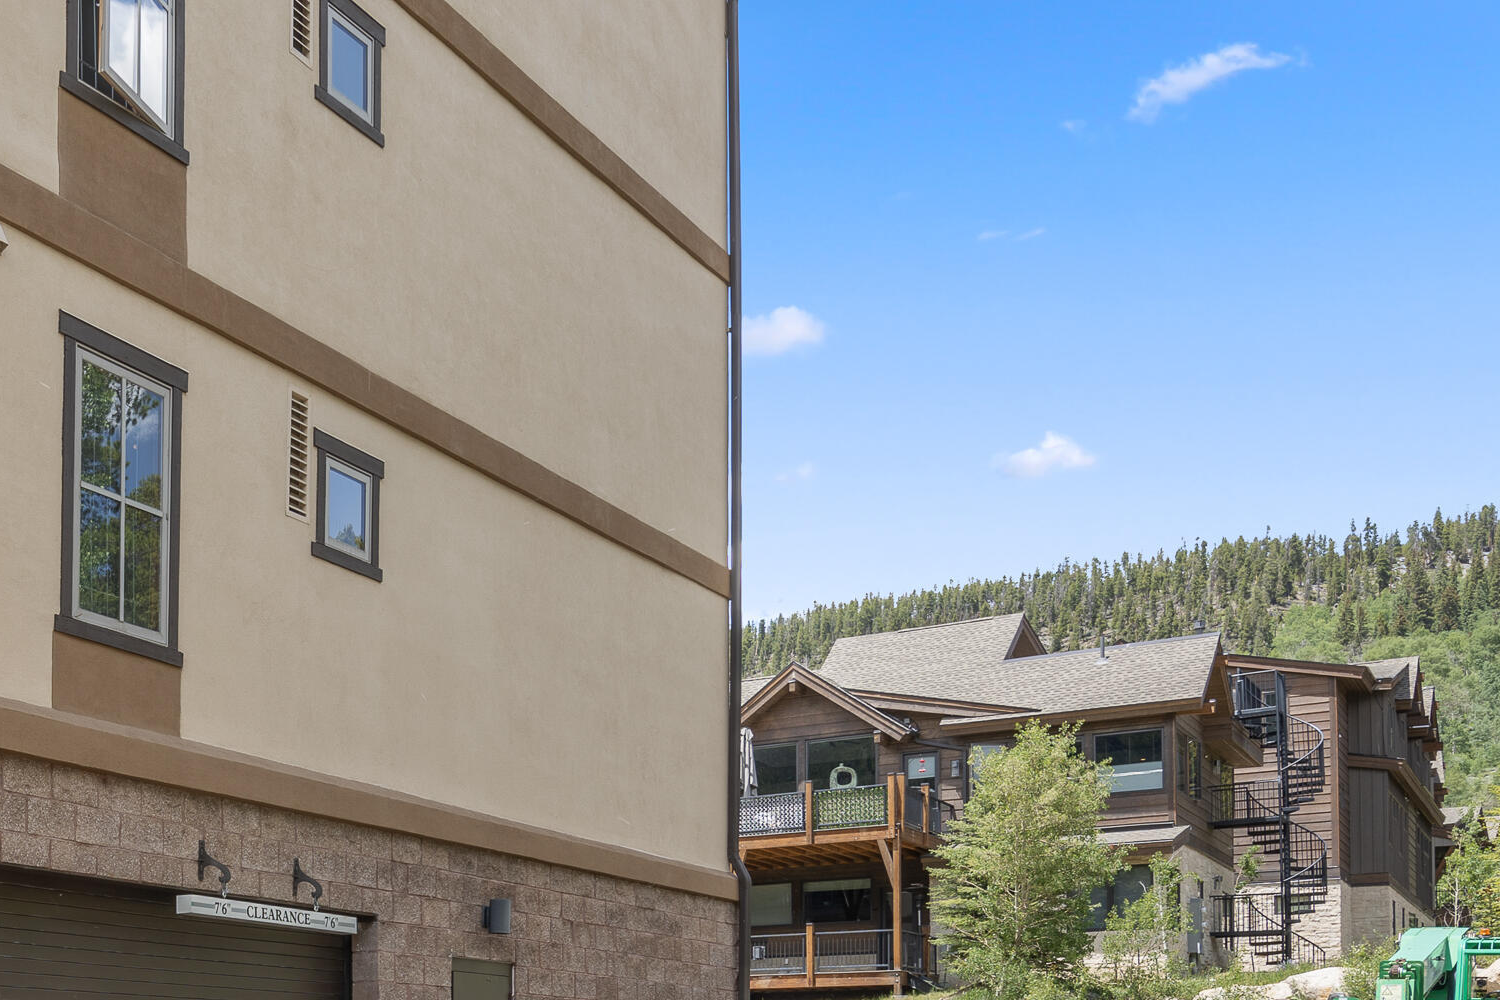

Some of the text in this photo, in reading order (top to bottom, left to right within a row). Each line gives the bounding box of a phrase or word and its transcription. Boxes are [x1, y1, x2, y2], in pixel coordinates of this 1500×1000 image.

[214, 902, 339, 929] 7'6" CLEARANCE 7'6"
